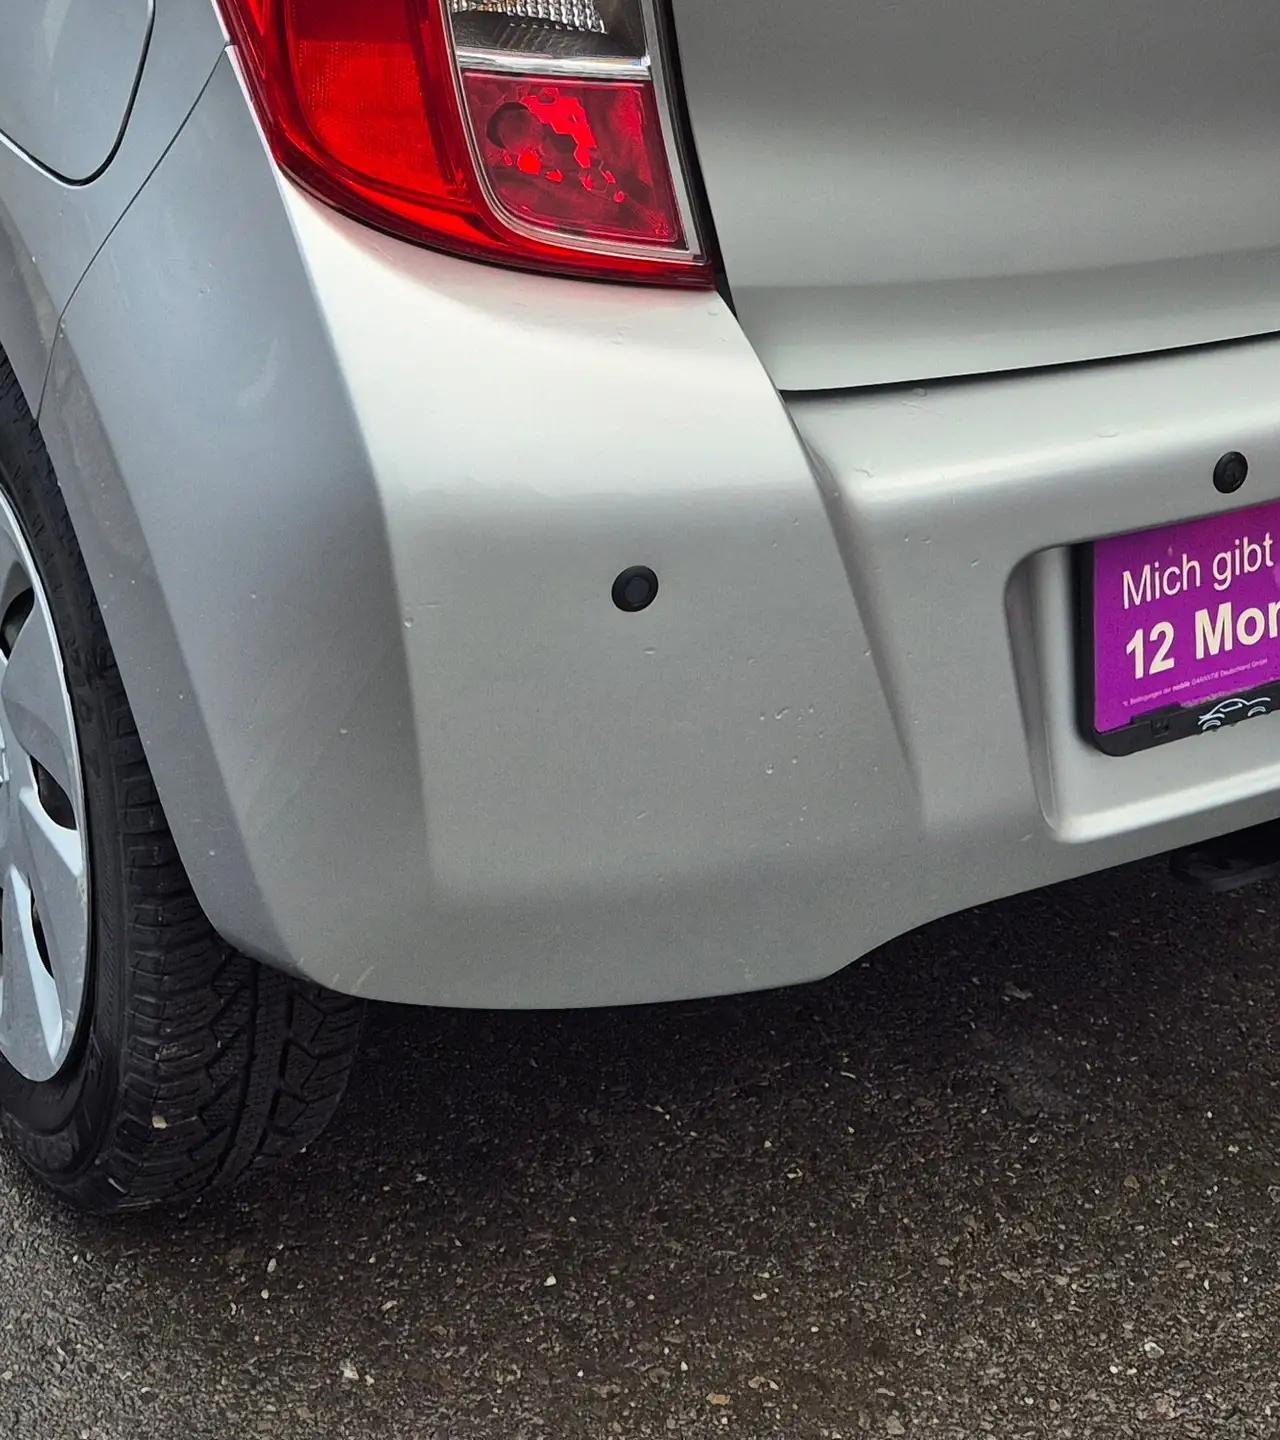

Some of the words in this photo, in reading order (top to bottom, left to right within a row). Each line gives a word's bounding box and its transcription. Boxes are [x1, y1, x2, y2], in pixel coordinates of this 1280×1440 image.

[1122, 553, 1201, 609] Mich
[1212, 532, 1274, 591] gibt
[1126, 621, 1175, 680] 12
